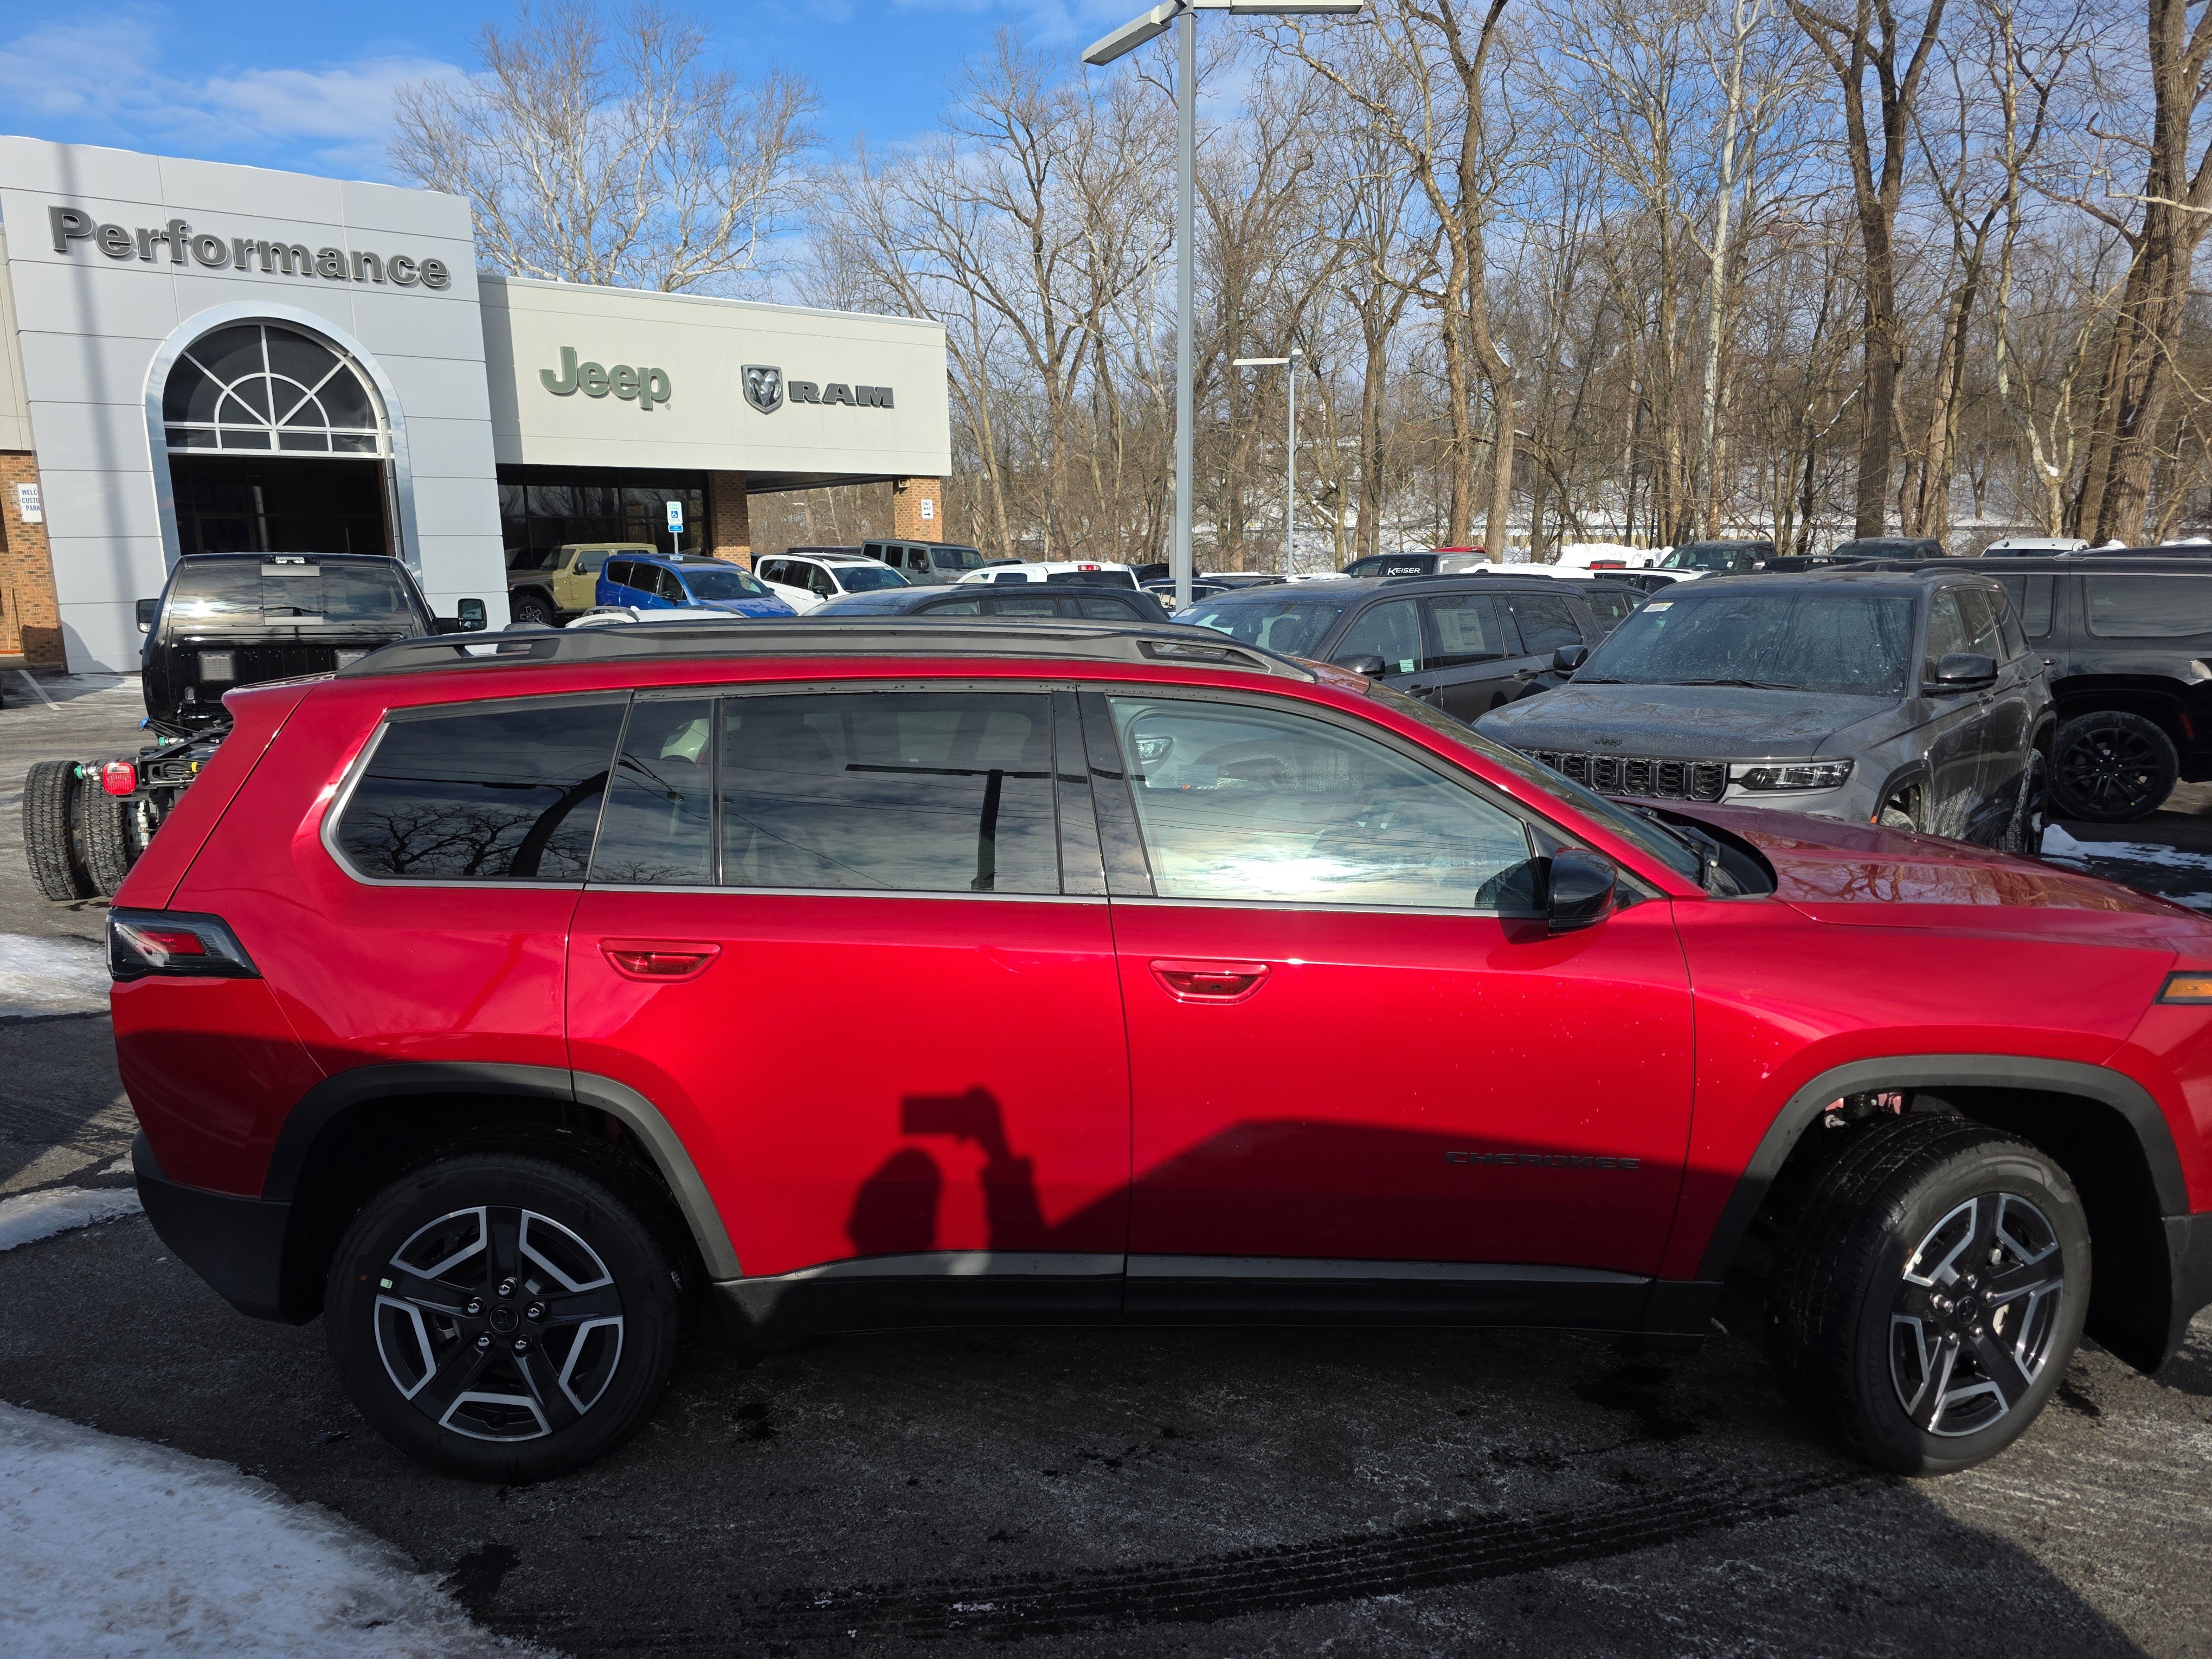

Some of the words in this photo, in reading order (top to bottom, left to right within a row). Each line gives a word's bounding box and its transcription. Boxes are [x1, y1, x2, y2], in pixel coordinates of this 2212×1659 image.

[48, 205, 451, 287] Performance
[539, 346, 671, 411] Jeep
[788, 381, 895, 409] RAM
[1594, 736, 1622, 748] Jeep
[1444, 1152, 1640, 1169] CHEROKEE
